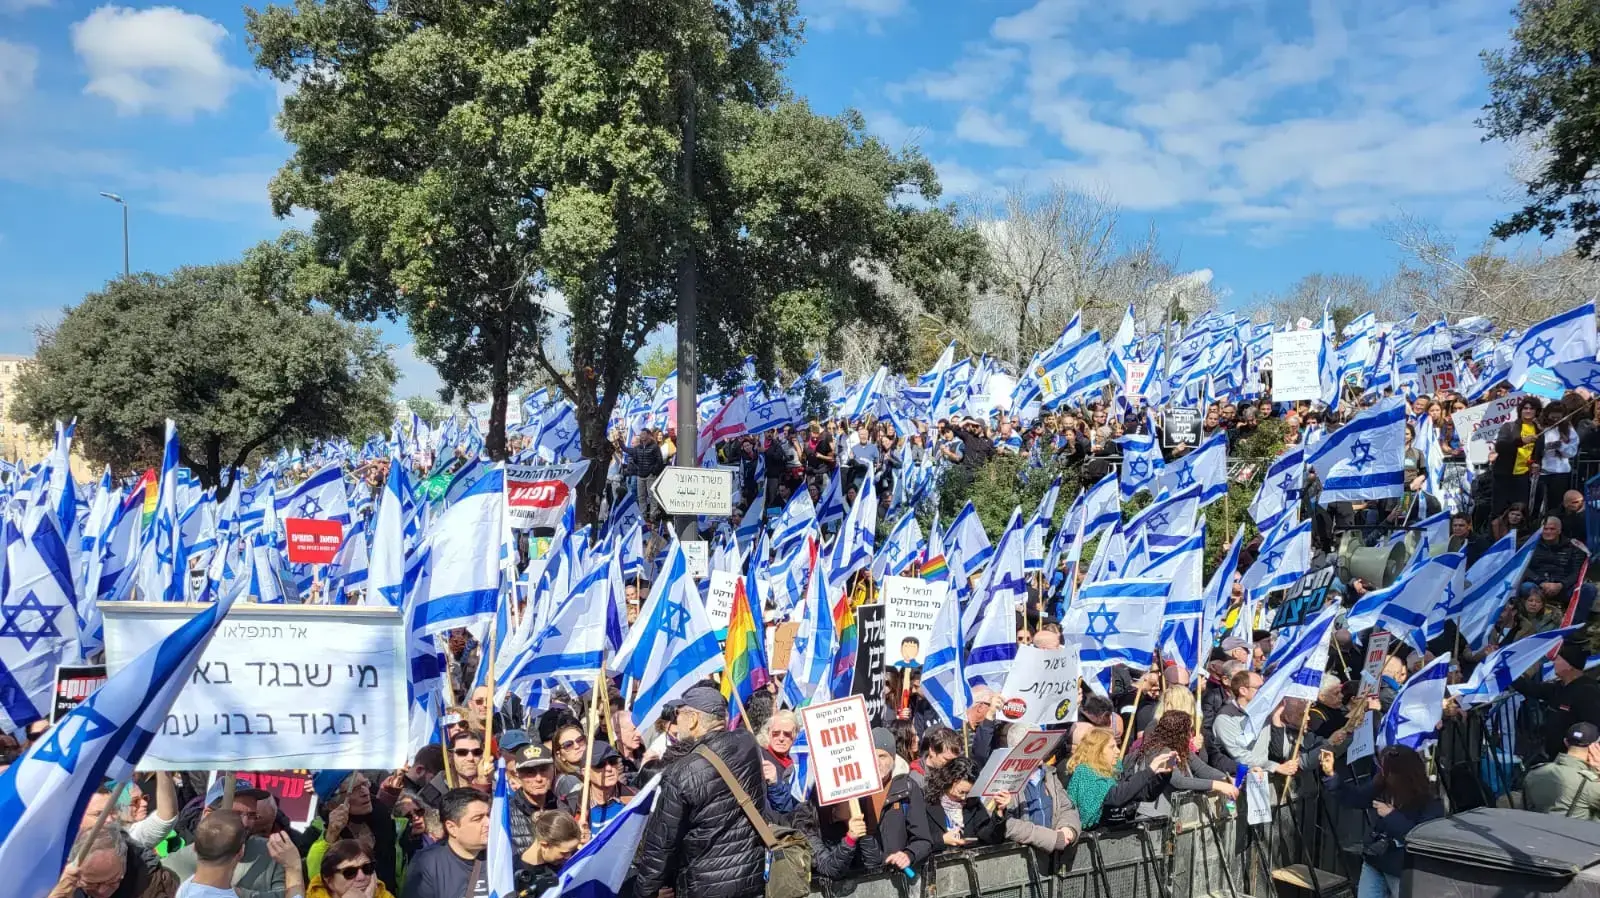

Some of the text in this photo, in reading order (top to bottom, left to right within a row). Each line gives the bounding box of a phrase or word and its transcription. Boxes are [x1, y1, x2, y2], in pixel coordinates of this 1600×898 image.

[675, 473, 723, 485] משרד האוצר
[510, 485, 556, 501] תפגע
[676, 486, 721, 500] وزارة المالية
[669, 499, 727, 509] Ministry of Finance
[713, 588, 734, 598] ודקט
[903, 585, 933, 596] תראו לי
[711, 608, 728, 618] הזה
[895, 608, 934, 620] שחשב על
[288, 623, 308, 640] אל
[890, 620, 906, 629] הזה
[223, 624, 284, 640] תתפלאו
[192, 661, 379, 688] מי שבגד בא
[161, 711, 368, 737] יבגוד בבני עמ
[820, 722, 858, 748] אזרח
[832, 761, 862, 788] נתין
